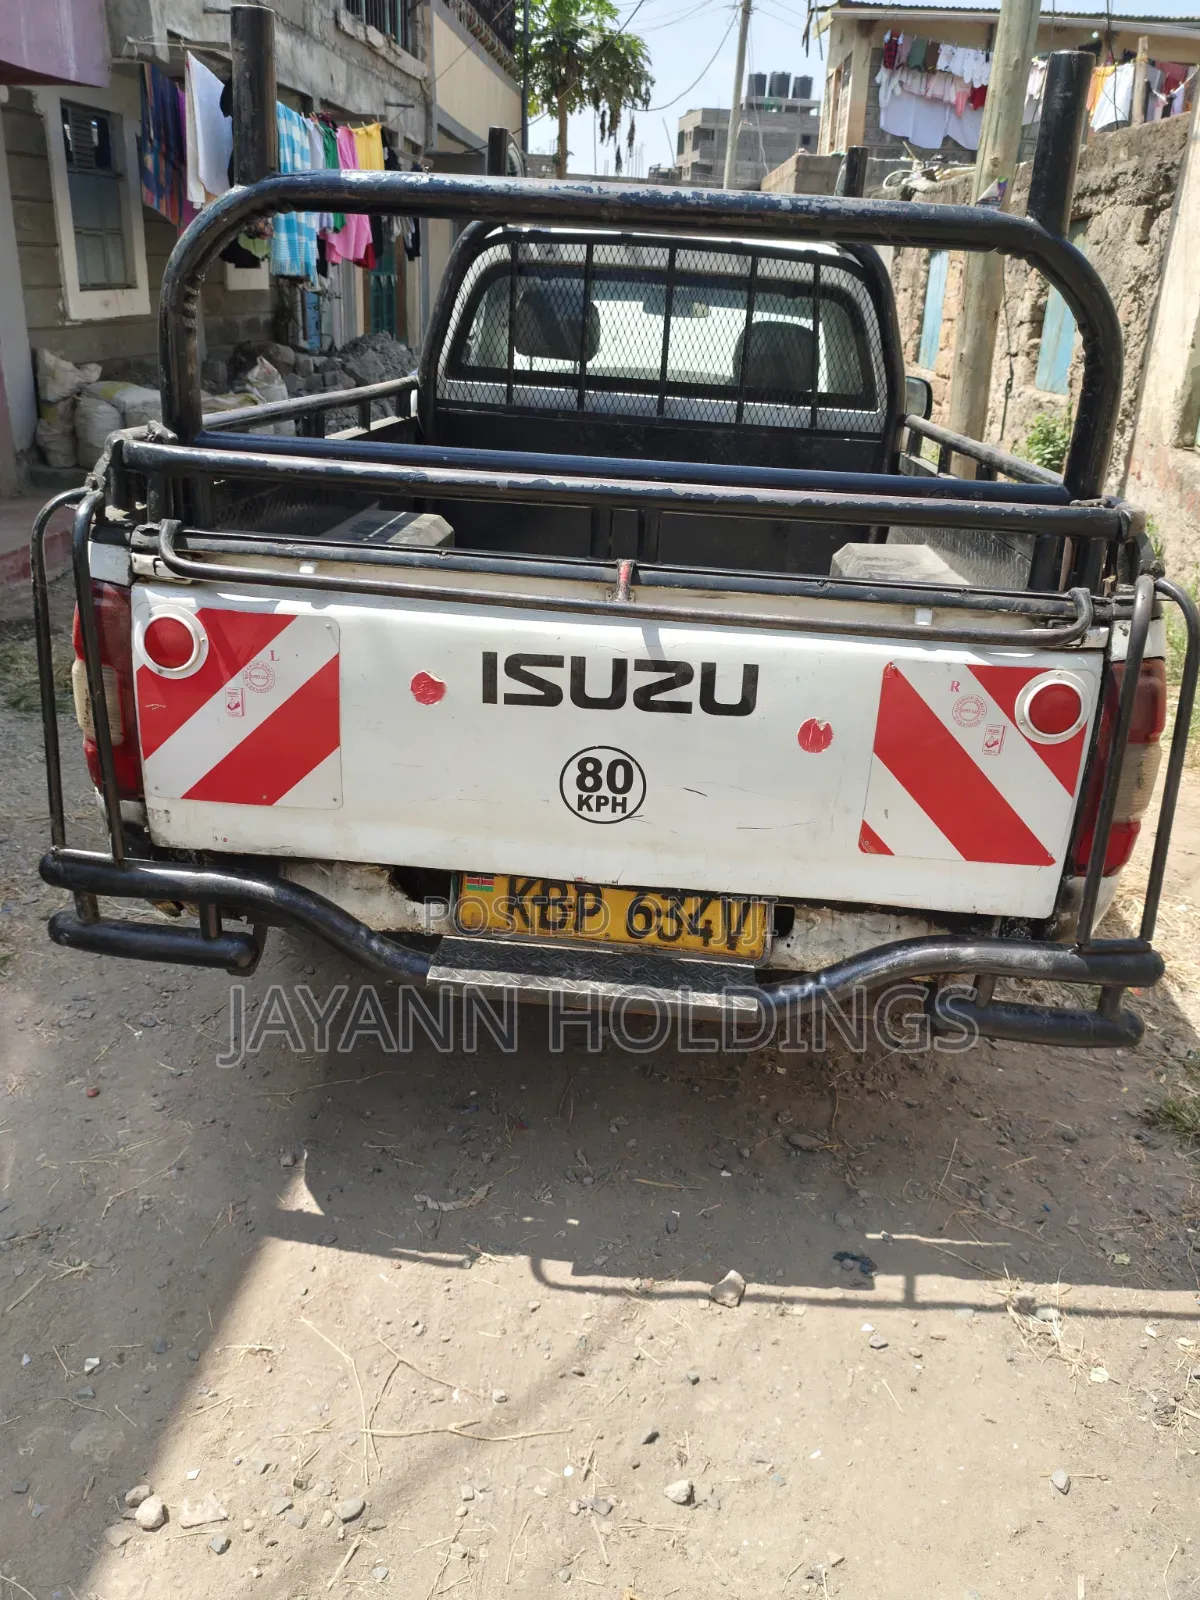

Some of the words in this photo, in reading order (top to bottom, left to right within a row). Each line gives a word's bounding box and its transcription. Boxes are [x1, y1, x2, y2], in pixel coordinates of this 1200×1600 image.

[269, 649, 280, 661] L
[482, 651, 759, 716] ISUZU
[950, 680, 960, 692] R
[576, 757, 634, 794] 80
[577, 794, 627, 814] KPH
